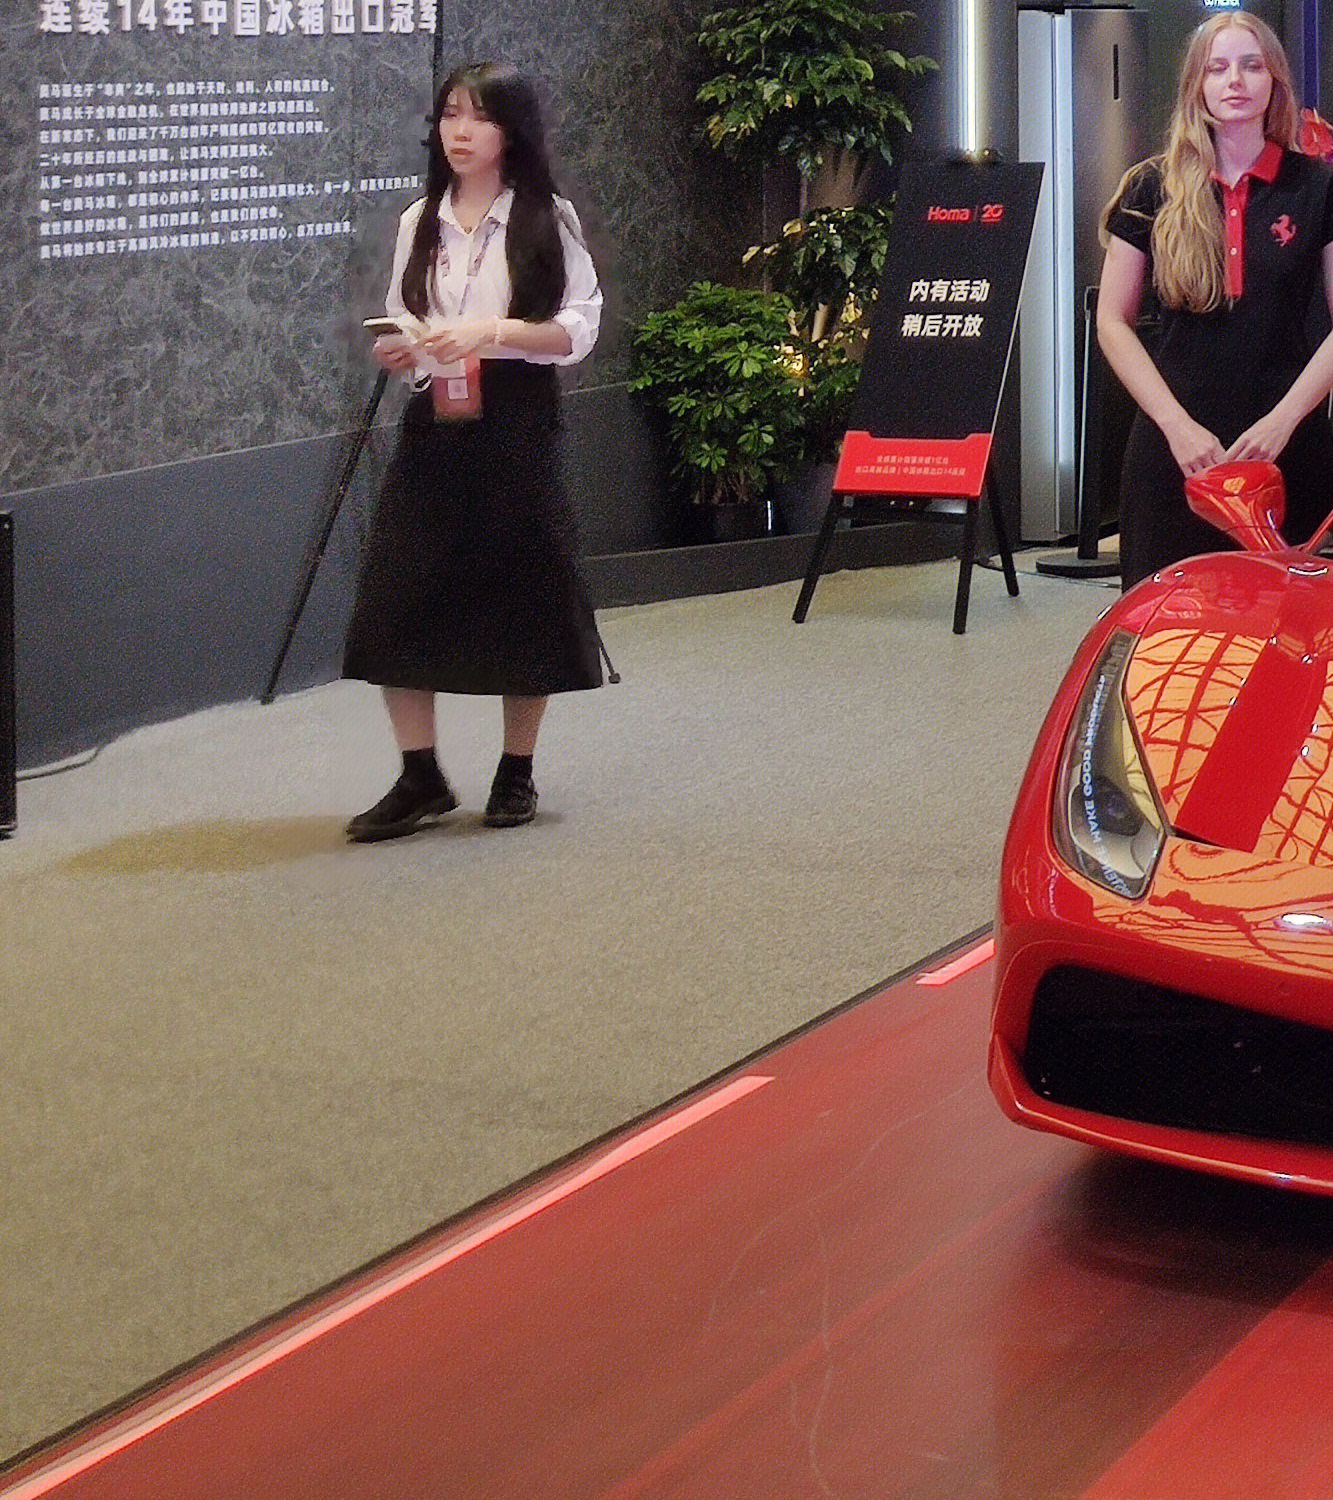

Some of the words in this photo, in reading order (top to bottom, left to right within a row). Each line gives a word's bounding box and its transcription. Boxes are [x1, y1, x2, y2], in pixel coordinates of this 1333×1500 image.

[928, 206, 971, 221] Homa
[908, 279, 991, 302] 内有活动
[900, 313, 984, 337] 稍后开放
